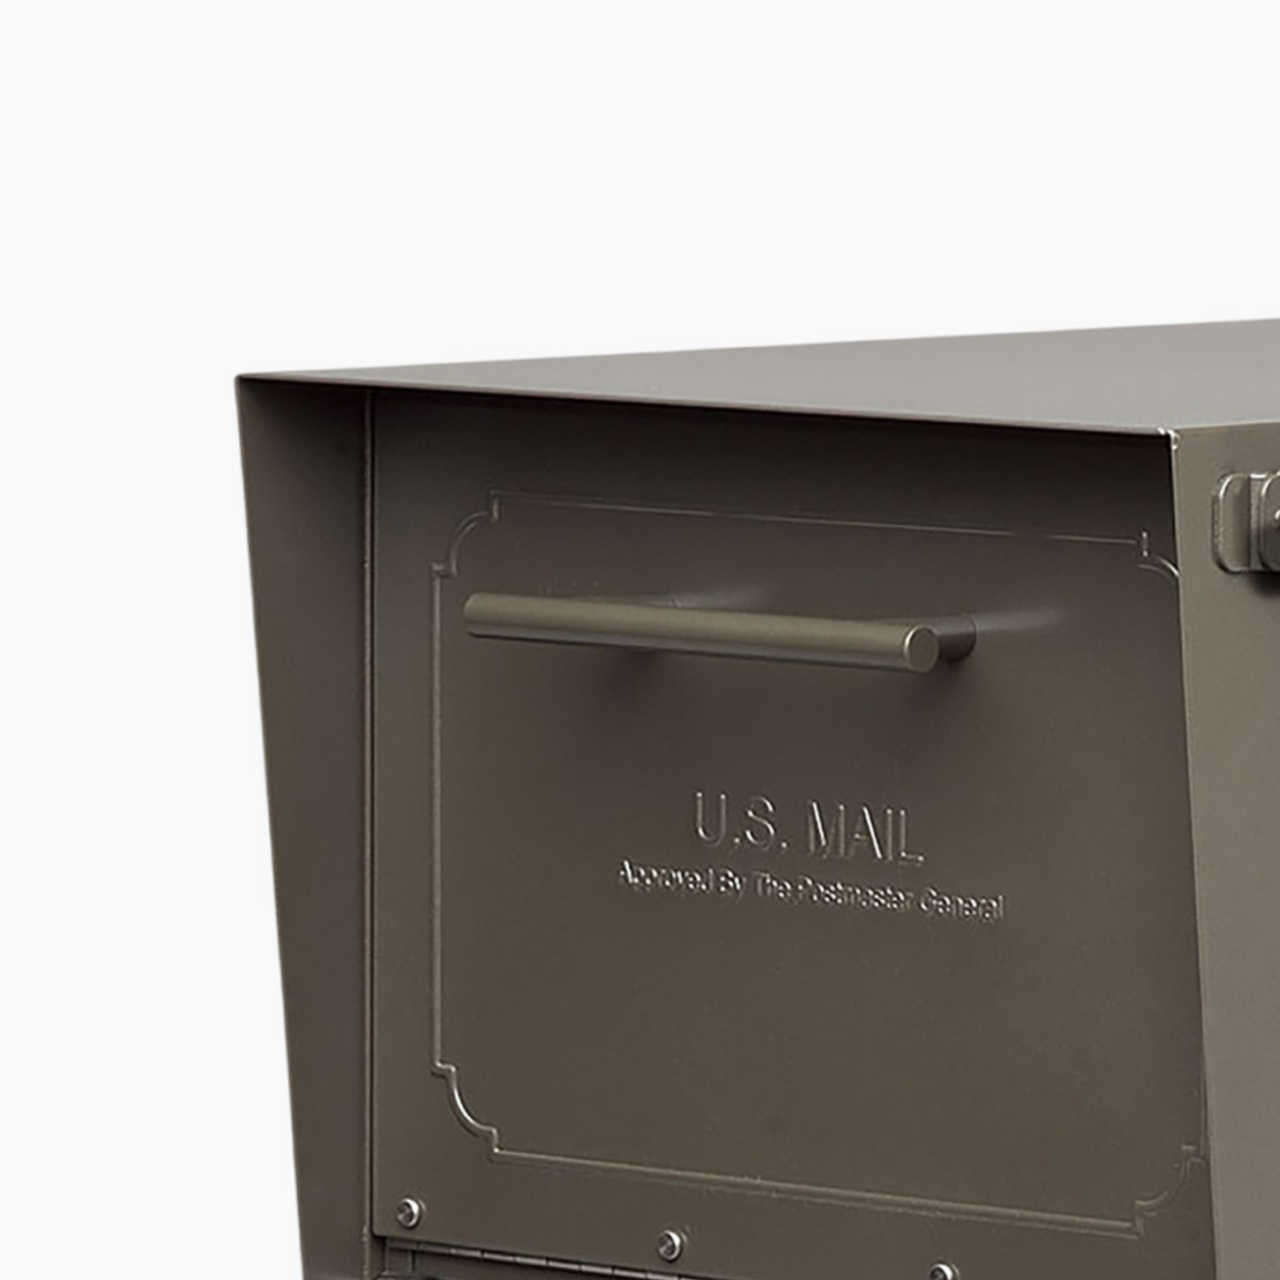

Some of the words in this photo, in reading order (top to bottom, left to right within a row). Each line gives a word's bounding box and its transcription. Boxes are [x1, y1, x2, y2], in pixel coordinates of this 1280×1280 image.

[695, 791, 789, 850] U.S.
[806, 801, 927, 867] MAIL
[617, 859, 715, 894] Approved
[719, 868, 747, 904] By
[752, 870, 795, 902] The
[798, 875, 915, 912] Postmaster
[919, 886, 1006, 923] General
